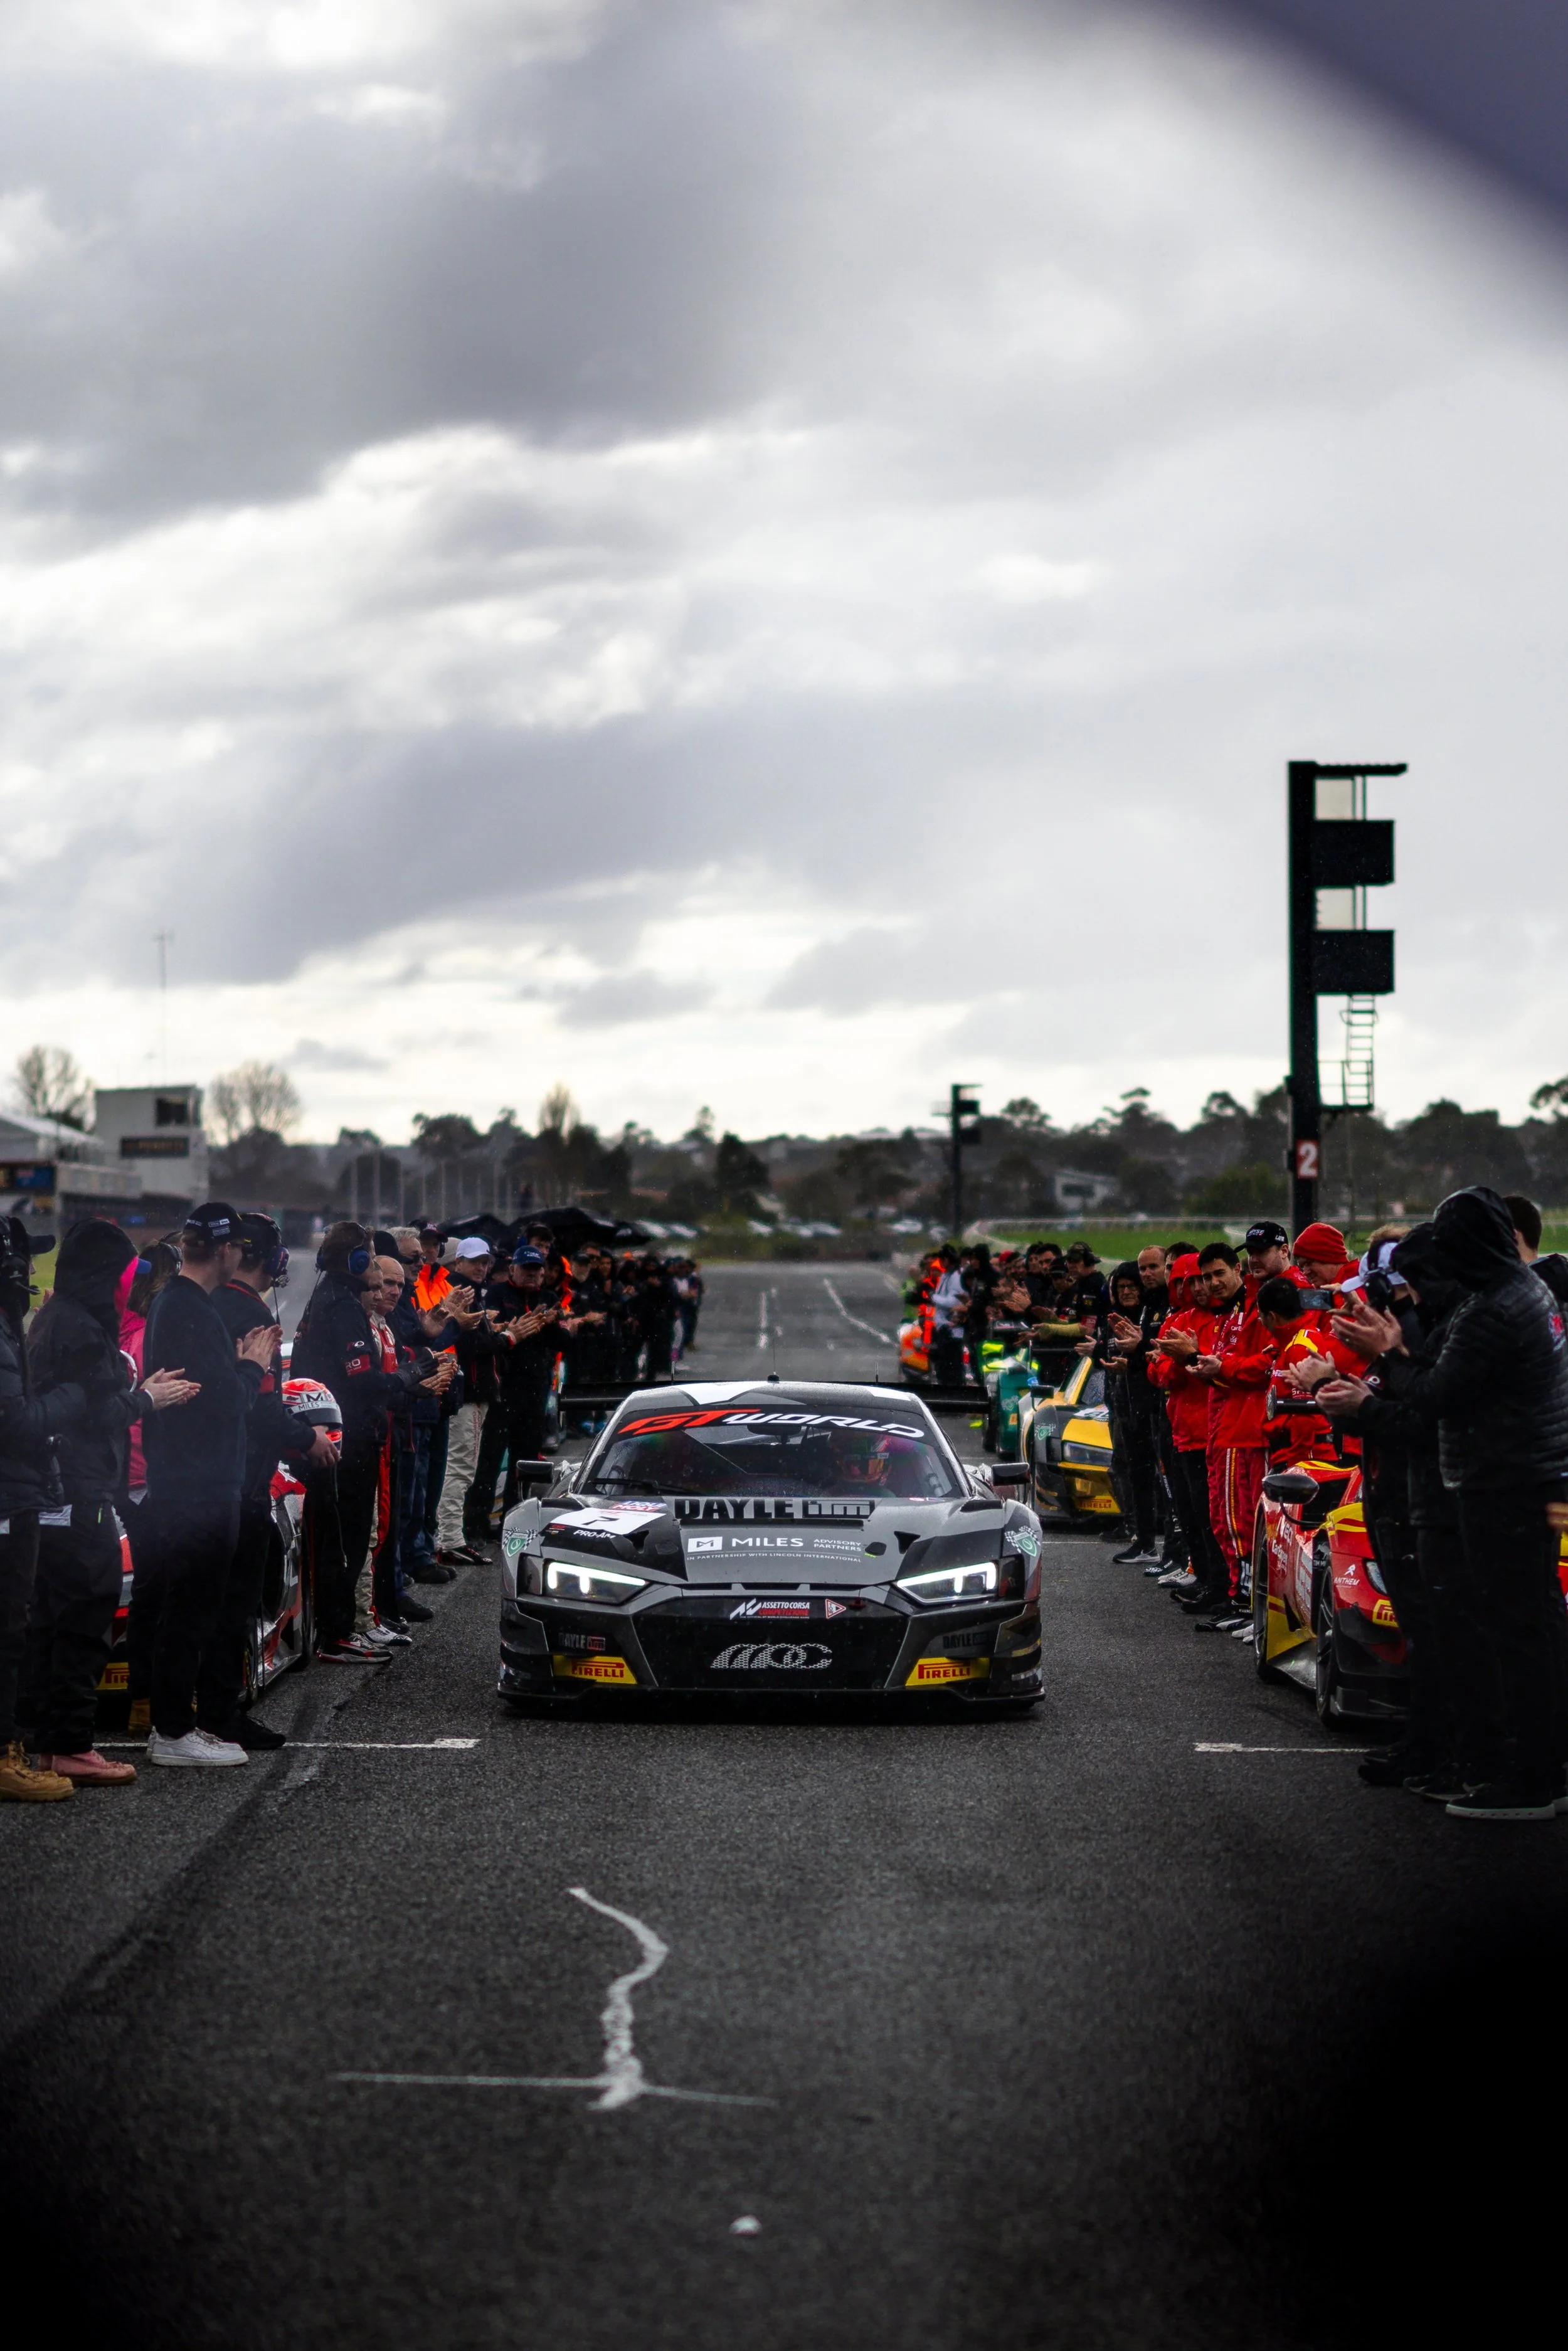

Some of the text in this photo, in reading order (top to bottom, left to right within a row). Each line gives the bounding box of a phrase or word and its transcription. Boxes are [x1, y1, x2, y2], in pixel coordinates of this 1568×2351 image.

[1299, 1143, 1316, 1176] 2
[298, 1401, 320, 1411] MILES
[618, 1409, 924, 1438] GT WORLD
[1079, 1498, 1111, 1508] PIRELLI
[674, 1498, 795, 1519] DAYLE
[573, 1529, 616, 1539] PRO-AM
[732, 1537, 803, 1547] MILES
[813, 1544, 862, 1552] PARTNERS
[803, 1554, 862, 1563] INTERNATIONAL
[1333, 1577, 1360, 1586] ANTHEM
[943, 1633, 972, 1649] DAYLE
[571, 1659, 625, 1678] PIRELLI
[918, 1661, 971, 1679] PIRELLI
